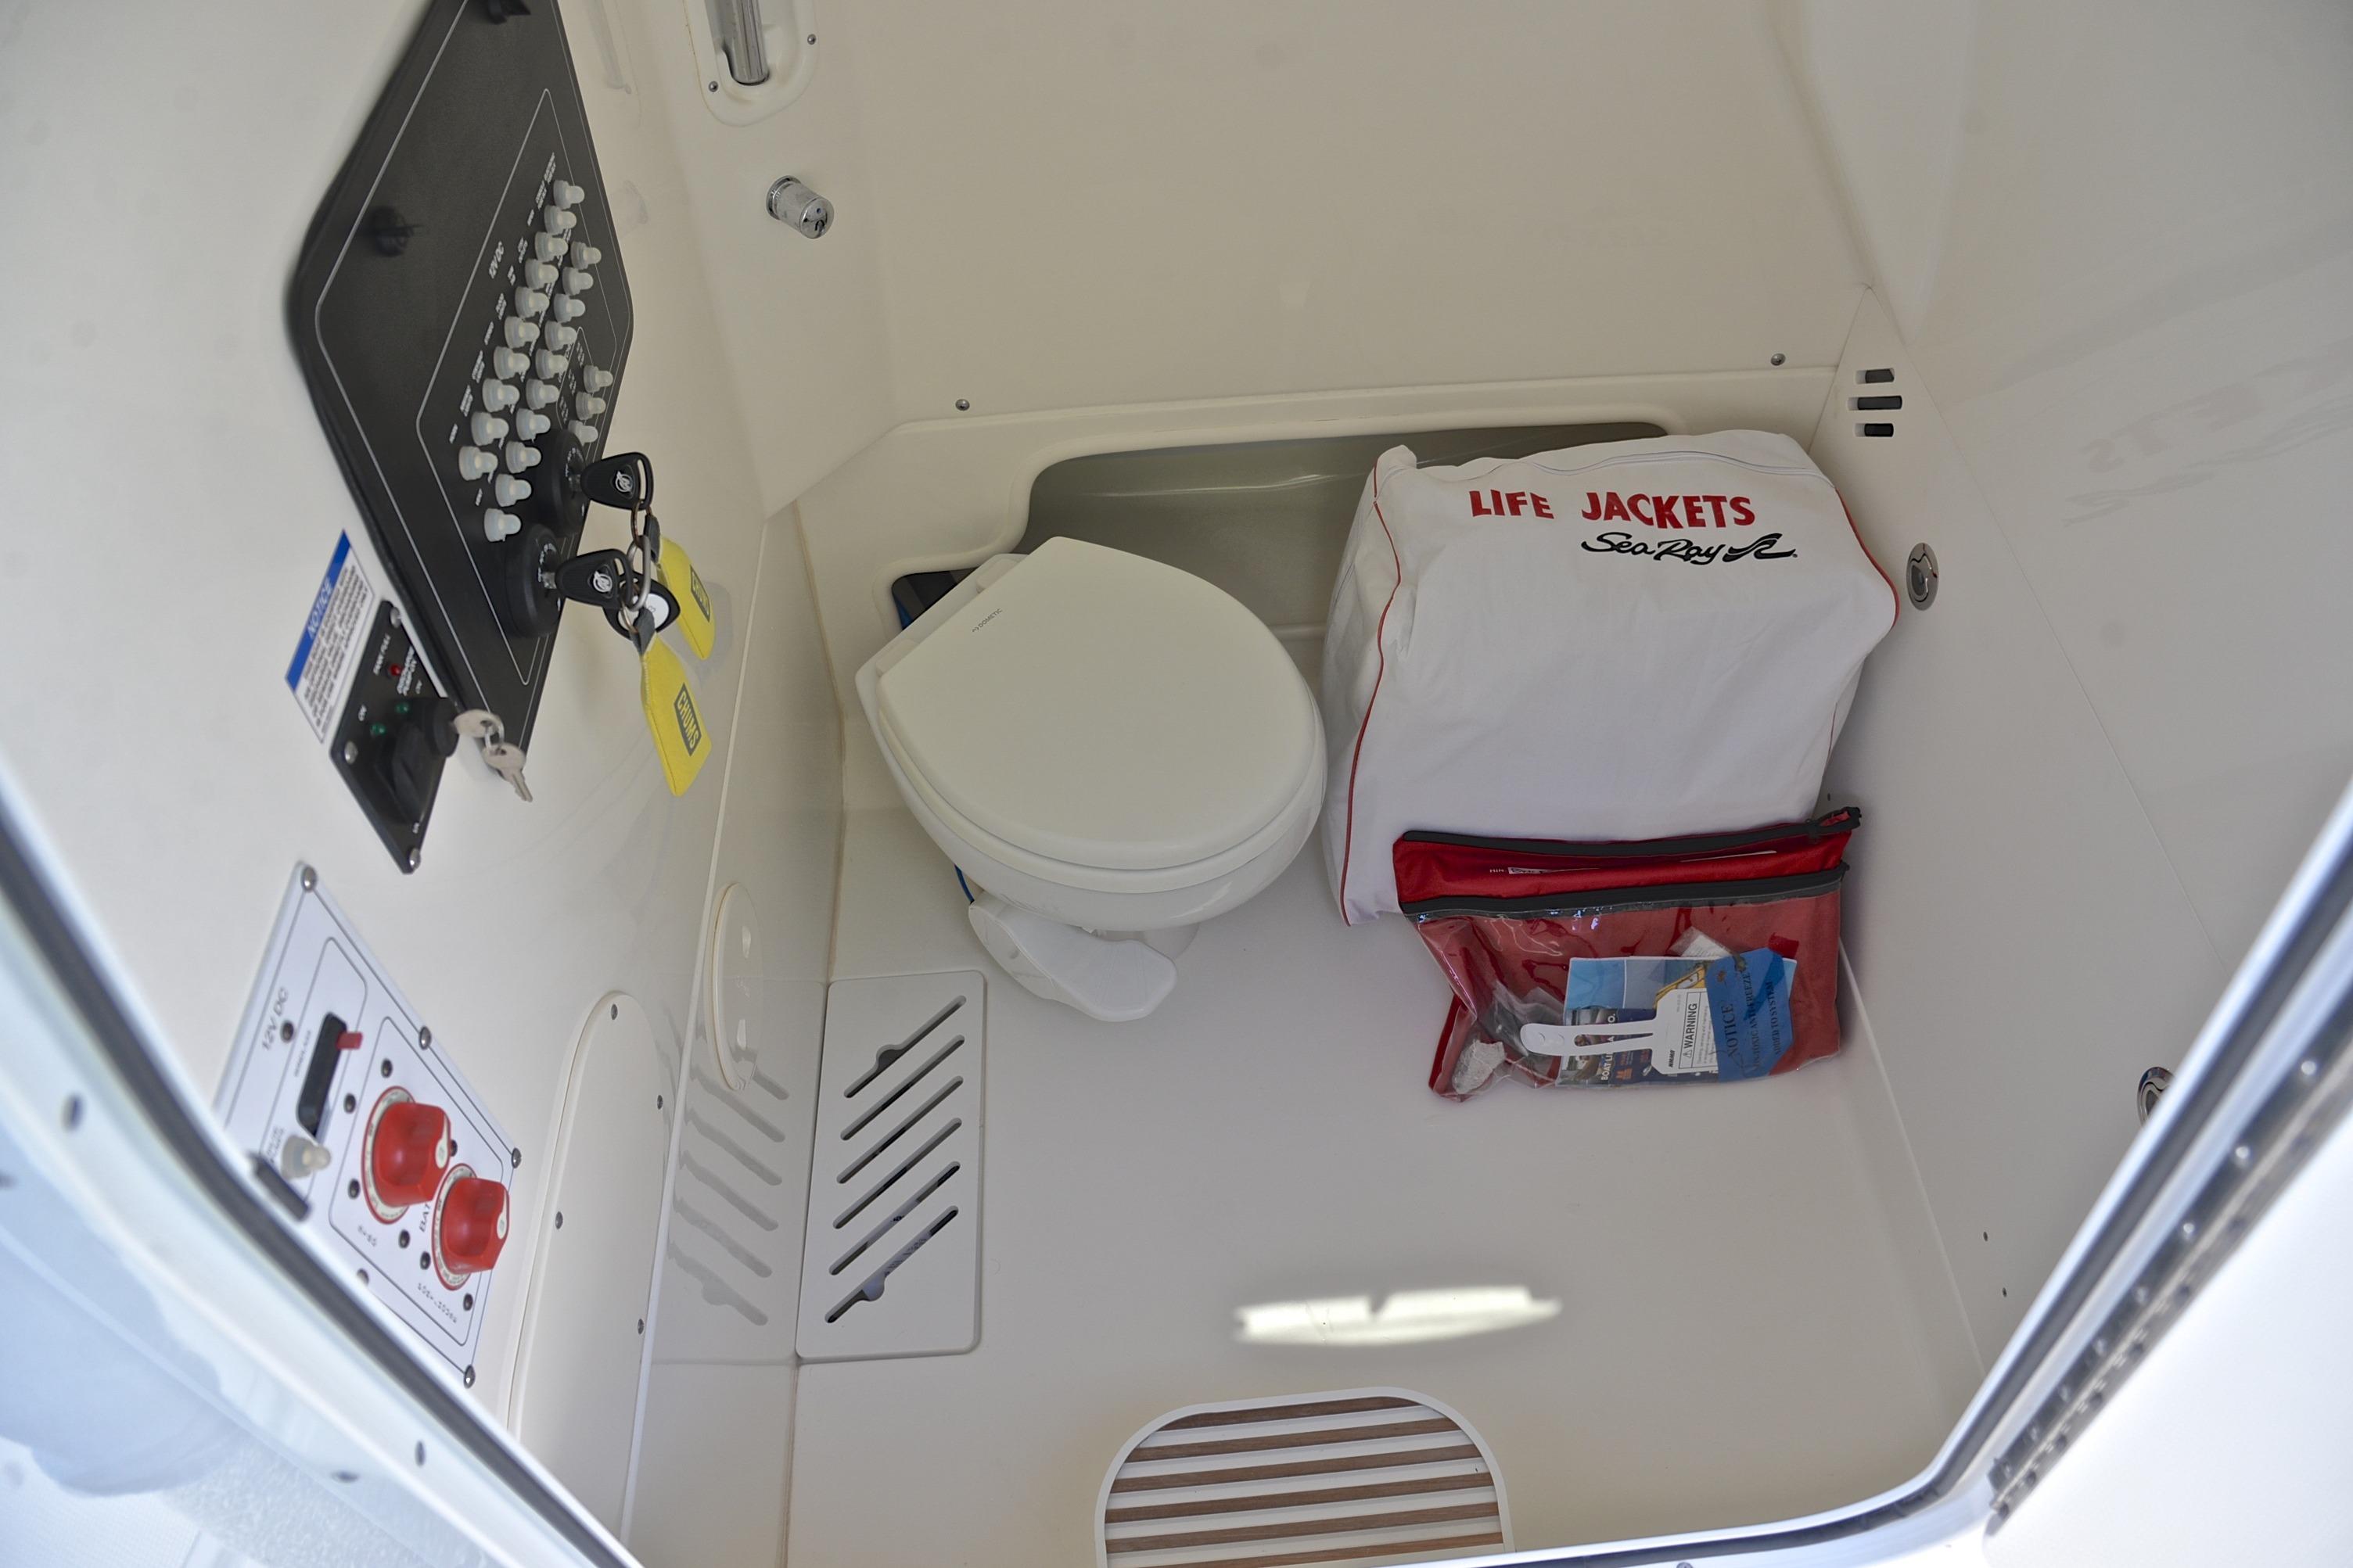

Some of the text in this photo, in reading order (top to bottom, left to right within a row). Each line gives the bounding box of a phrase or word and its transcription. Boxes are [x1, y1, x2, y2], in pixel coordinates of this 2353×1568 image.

[1469, 490, 1756, 529] LIFE JACKETS
[1581, 532, 1725, 565] Sea Ray
[307, 577, 332, 640] NOTICE
[978, 608, 1003, 628] DOMETIC
[677, 693, 700, 748] CHUMS
[261, 987, 288, 1050] 12V DC
[1683, 1003, 1697, 1049] WARNING
[1722, 1004, 1739, 1057] NOTICE
[1771, 1020, 1779, 1029] TO
[1600, 1060, 1612, 1080] BOAT
